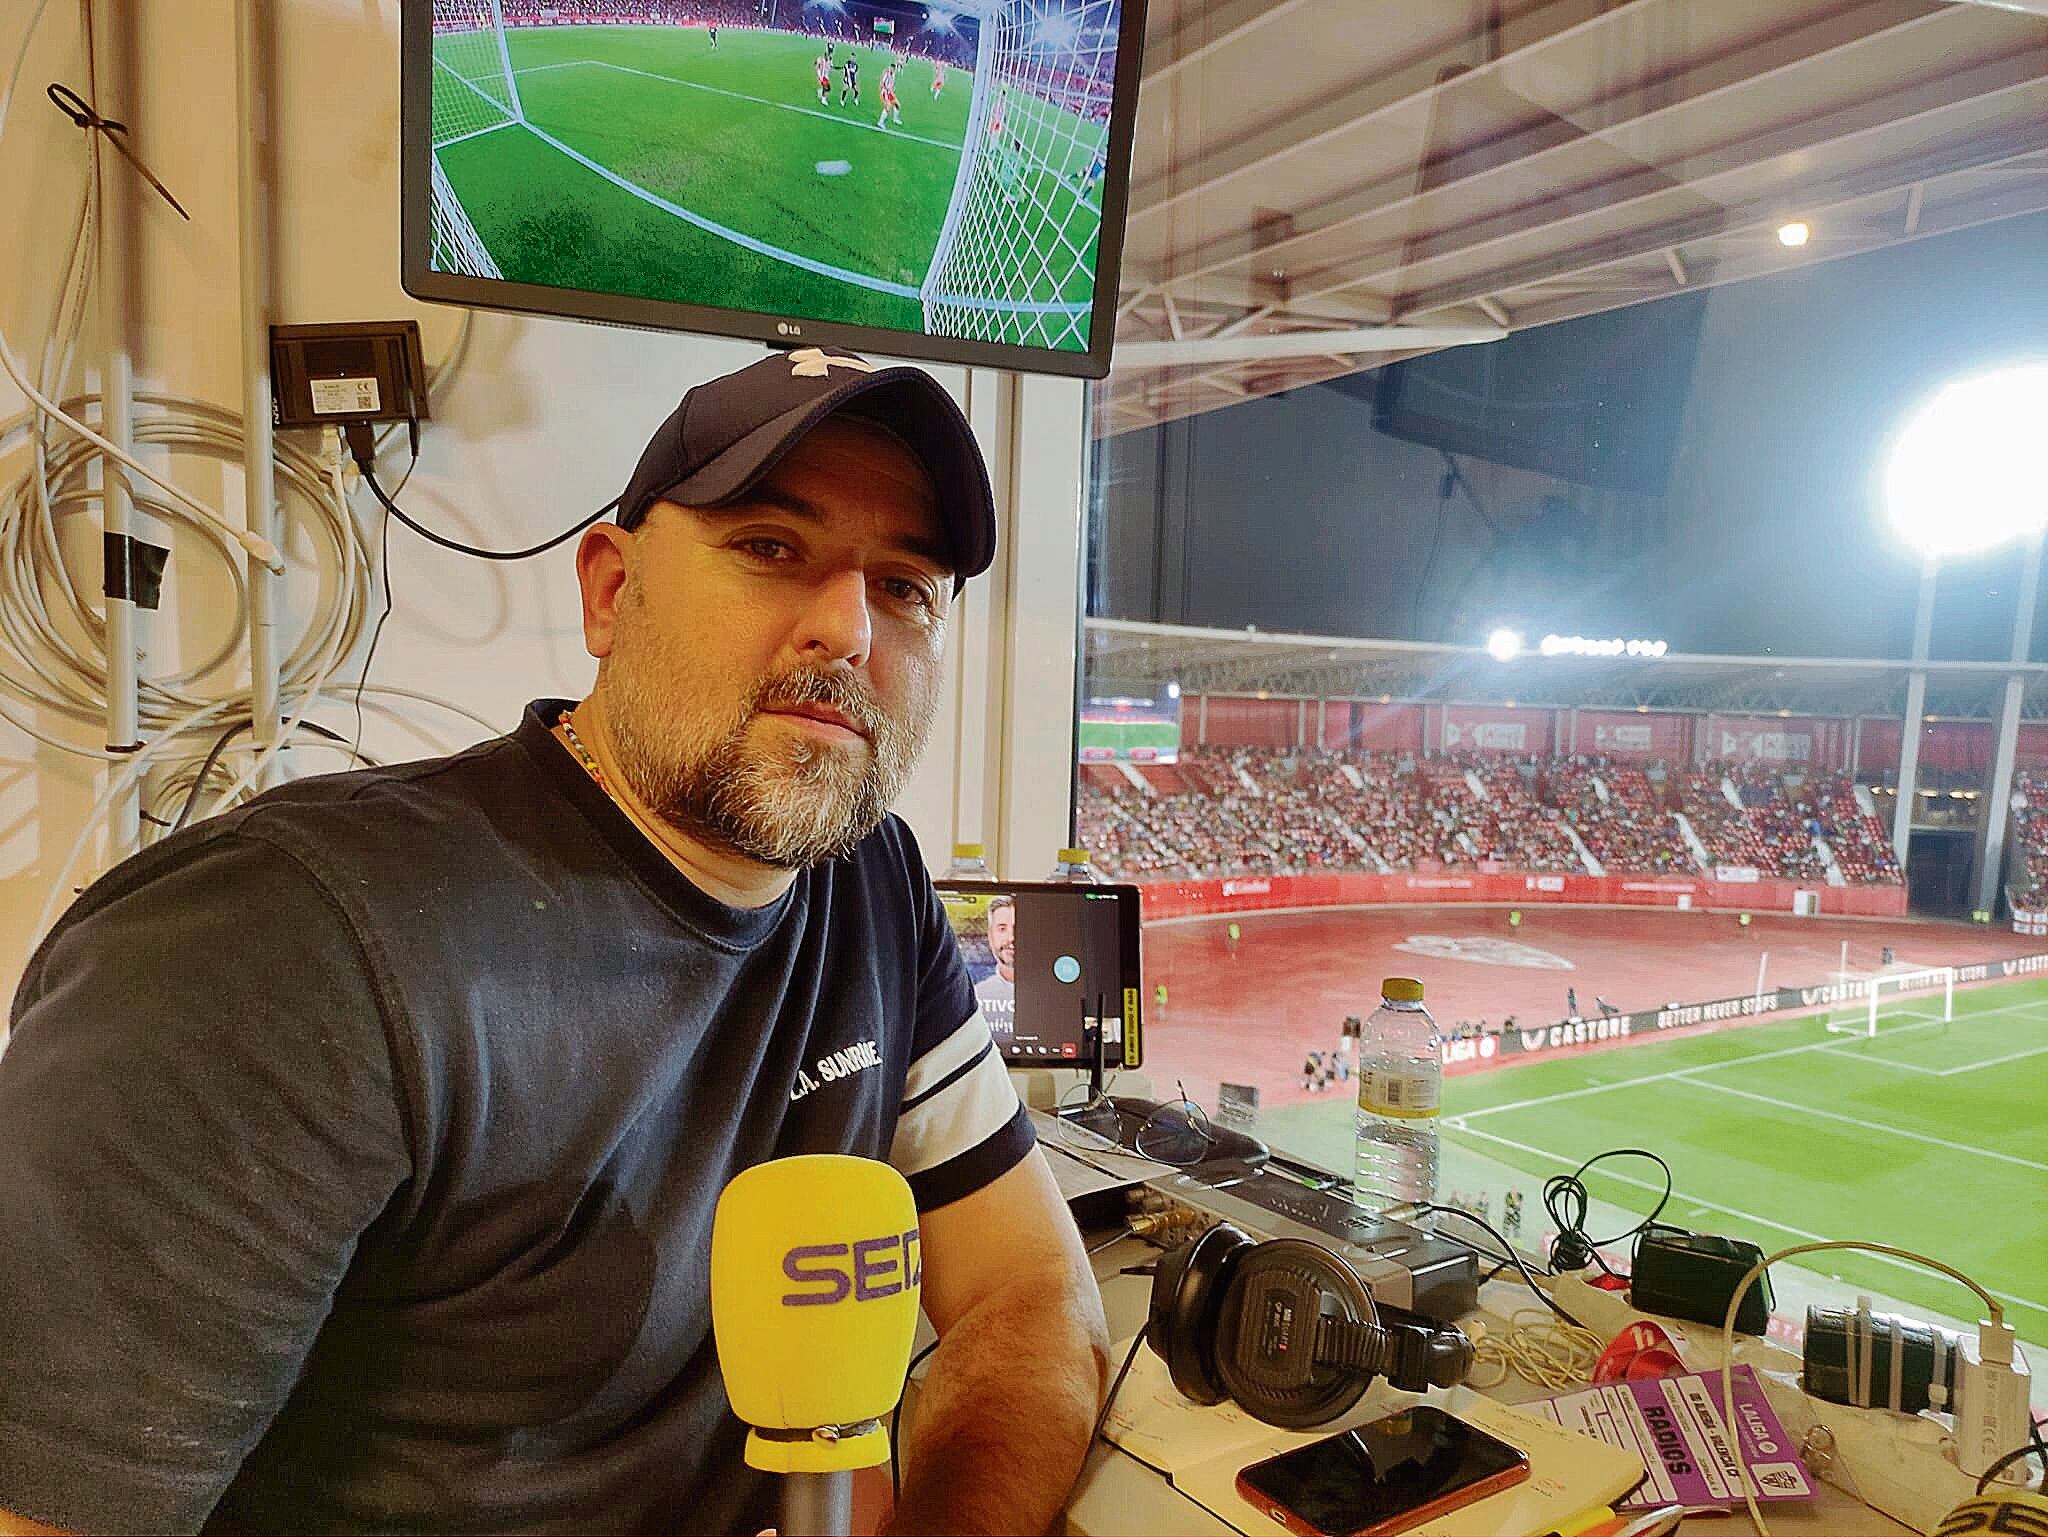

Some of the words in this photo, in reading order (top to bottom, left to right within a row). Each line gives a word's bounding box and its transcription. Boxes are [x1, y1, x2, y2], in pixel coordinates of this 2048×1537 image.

[788, 324, 801, 336] LG
[1822, 980, 1872, 1003] CASTO
[1703, 1000, 1741, 1021] NEVER
[1742, 994, 1777, 1015] STPS
[1549, 1016, 1632, 1047] CASTORE
[817, 1040, 883, 1081] SUNRIE
[1738, 1403, 1772, 1440] LALIGA
[1644, 1406, 1692, 1474] RADIOS
[1709, 1435, 1734, 1467] VALENCIA
